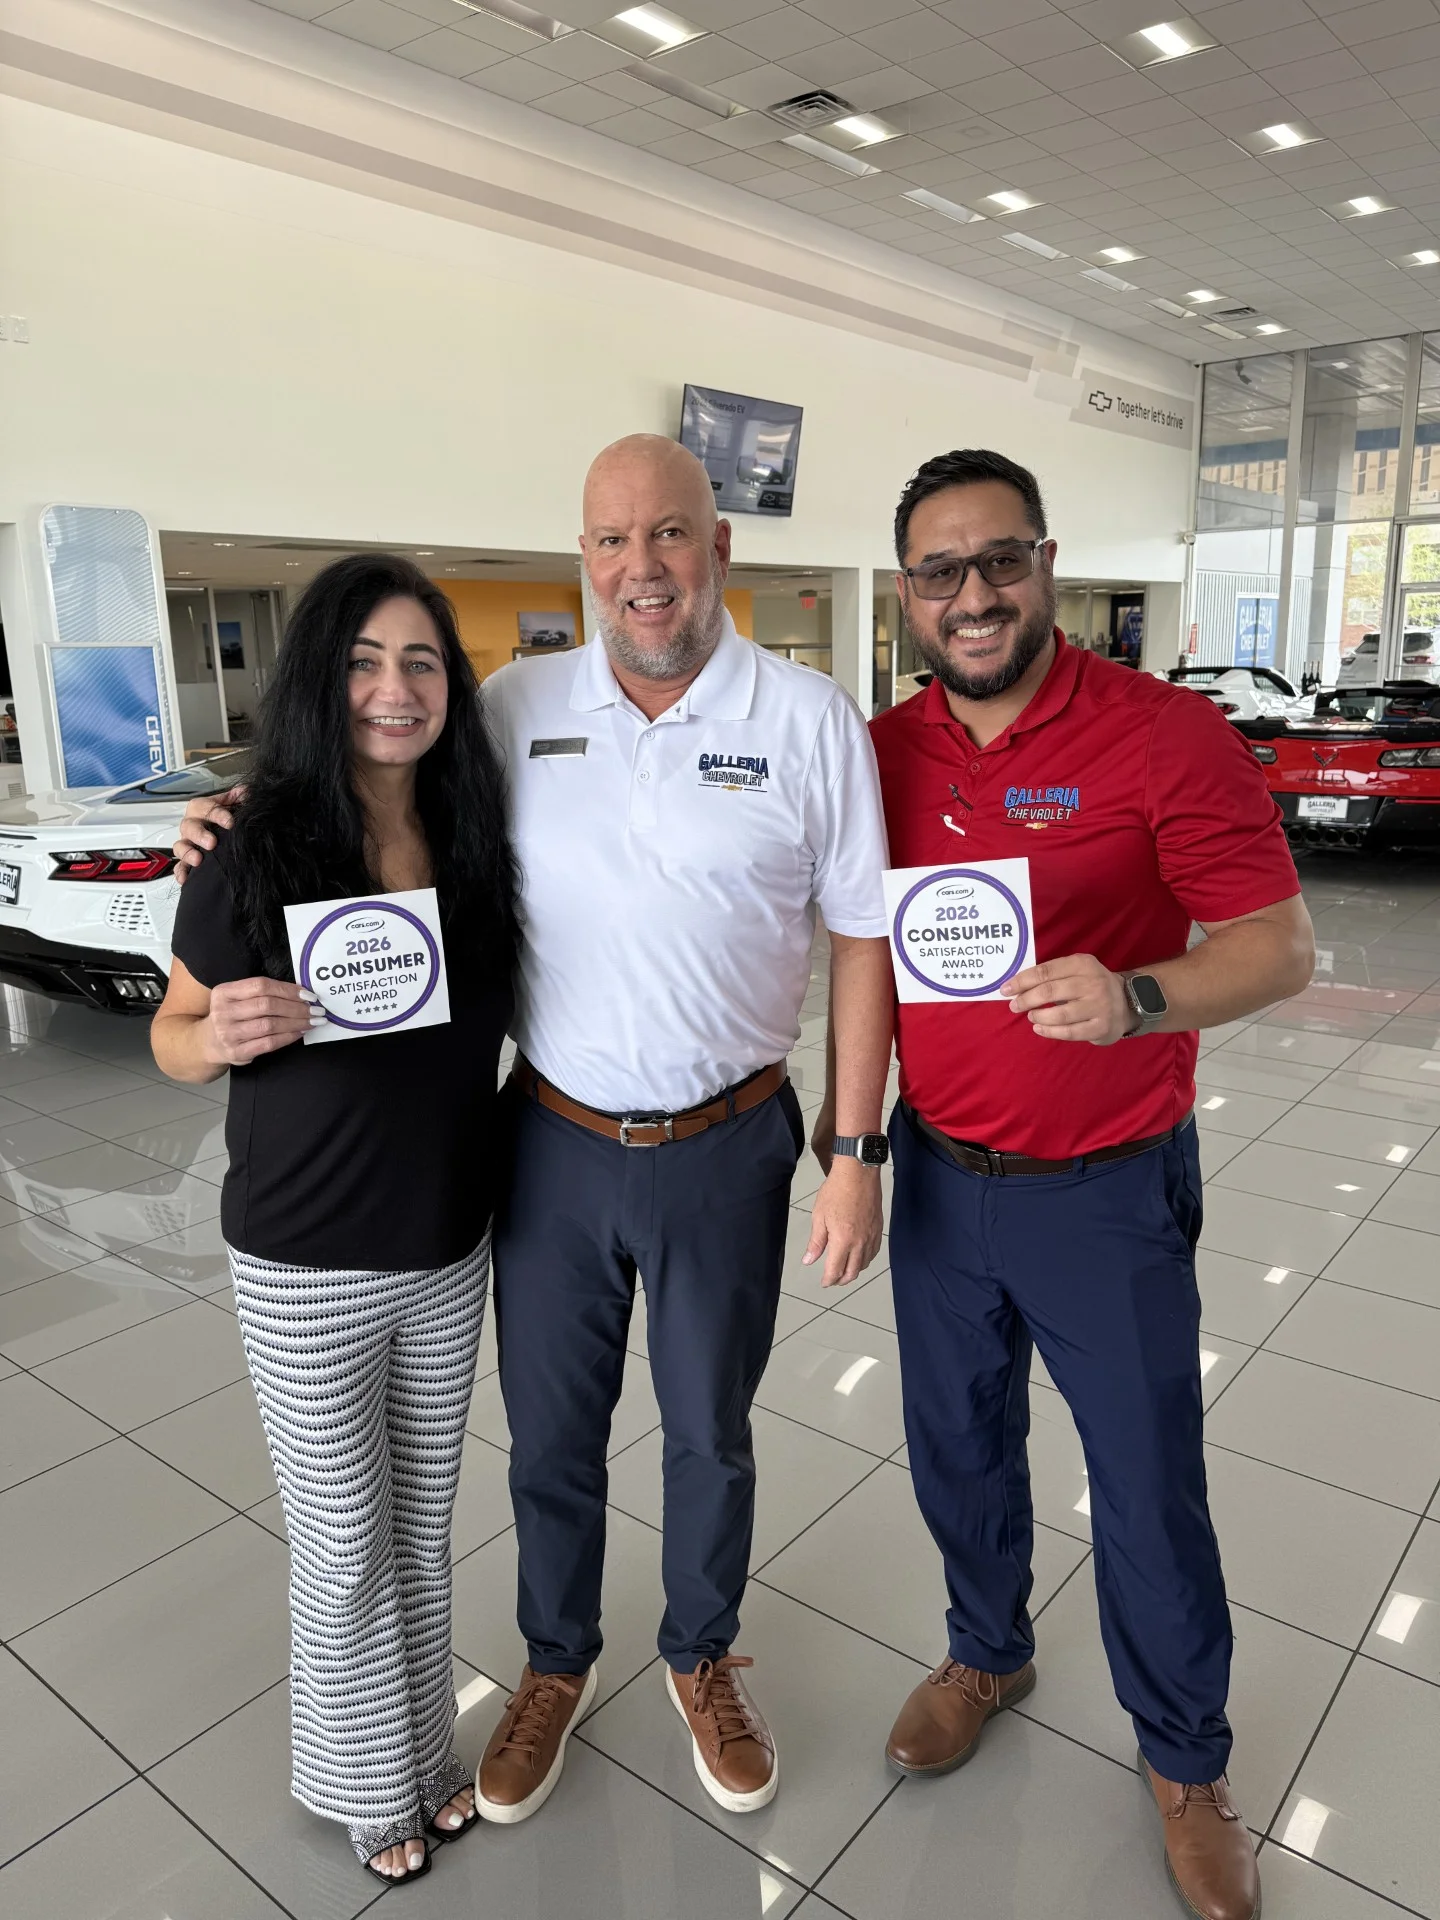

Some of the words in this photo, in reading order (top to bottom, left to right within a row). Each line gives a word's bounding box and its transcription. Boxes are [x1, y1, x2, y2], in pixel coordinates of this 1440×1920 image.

[1116, 397, 1150, 419] Together
[1151, 406, 1165, 425] let's
[1166, 410, 1183, 430] drive
[1240, 633, 1270, 651] CHEVOLET
[698, 753, 769, 779] GALLERIA
[702, 770, 765, 787] CHEVROLET
[1004, 786, 1080, 811] GALLERIA
[1307, 800, 1336, 811] GALLERIA
[1007, 807, 1073, 821] CHEVROLET
[941, 888, 969, 896] cars.com
[935, 904, 980, 921] 2026
[350, 920, 380, 929] cars.com
[907, 923, 1013, 943] CONSUMER
[345, 936, 392, 957] 2026
[919, 944, 1005, 958] SATISFACTION
[315, 952, 426, 981] CONSUMER
[941, 958, 984, 969] AWARD
[329, 972, 418, 996] SATISFACTION
[353, 989, 398, 1005] AWARD
